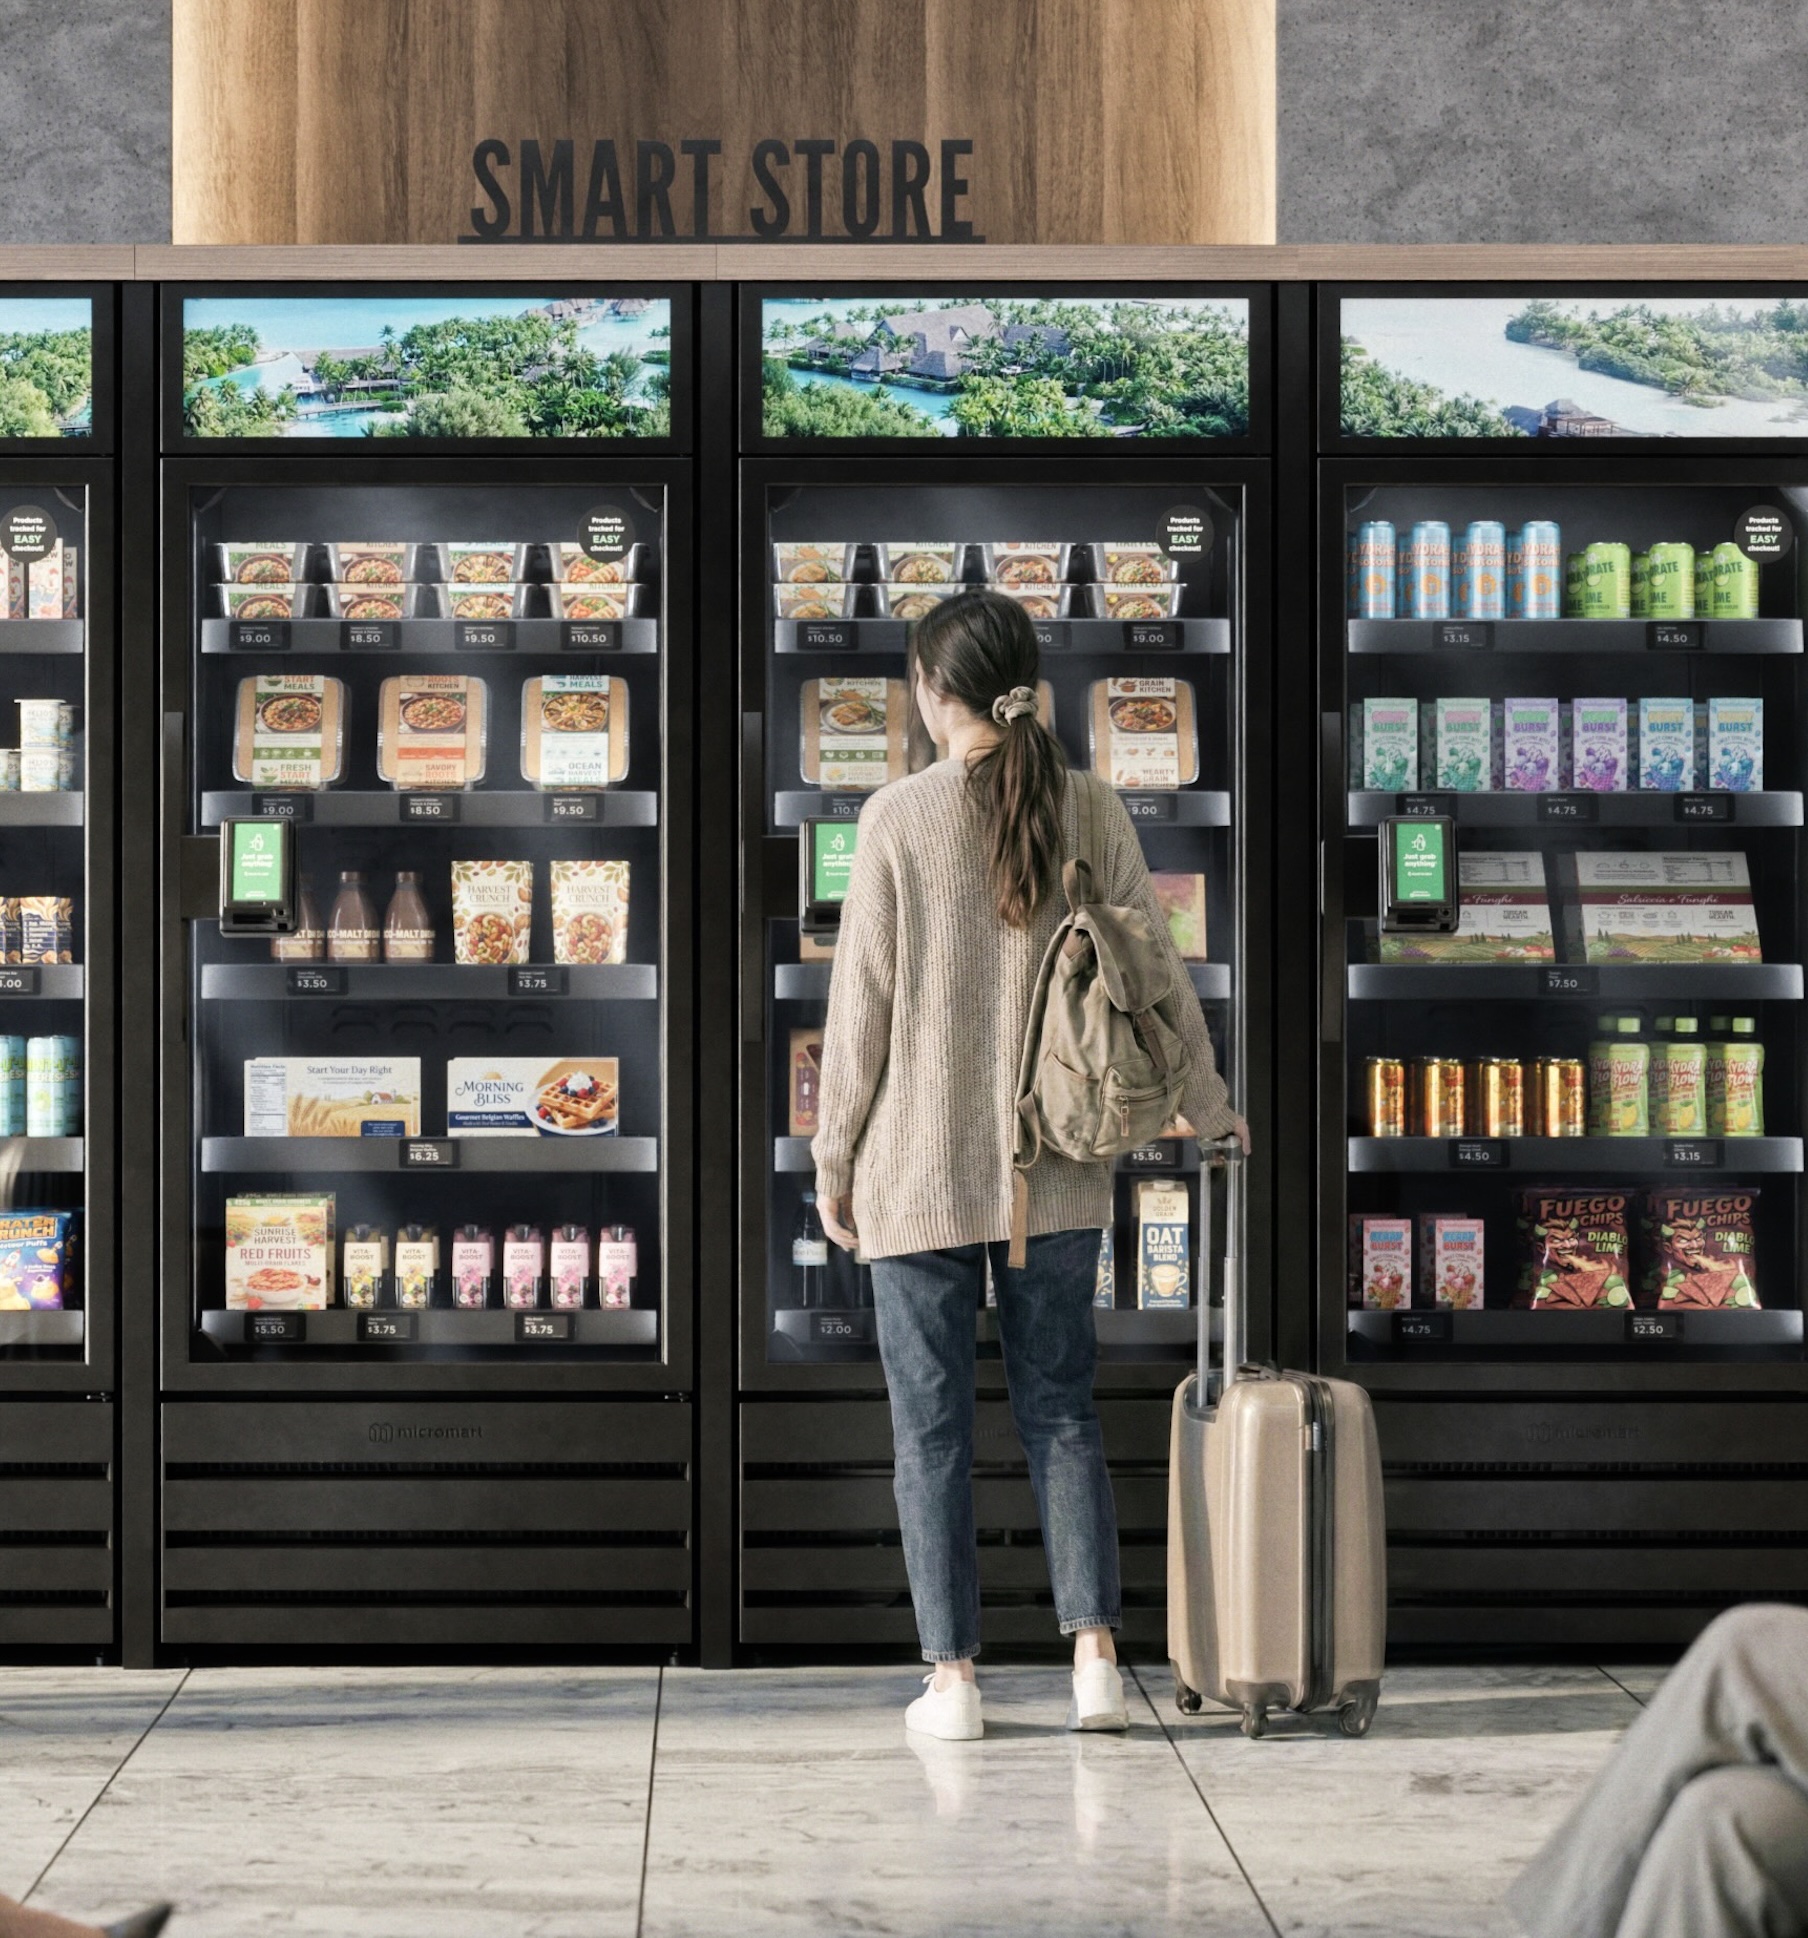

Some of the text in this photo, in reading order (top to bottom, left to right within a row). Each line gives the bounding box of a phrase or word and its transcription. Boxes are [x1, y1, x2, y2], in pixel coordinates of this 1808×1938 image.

[471, 139, 973, 238] SMART STORE
[588, 525, 625, 533] tracked for
[14, 535, 41, 543] EASY
[593, 535, 620, 543] EASY
[1171, 535, 1199, 543] EASY
[1750, 535, 1778, 543] EASY
[1025, 583, 1056, 591] KITCHEN
[240, 634, 270, 643] $9.00
[351, 634, 380, 643] $8.50
[465, 634, 495, 643] $9.50
[572, 634, 606, 643] $10.50
[808, 634, 842, 643] $10.50
[1133, 634, 1164, 643] $9.00
[1444, 635, 1469, 643] $3.15
[1657, 635, 1687, 643] $4.50
[1446, 723, 1480, 733] BURST
[1514, 723, 1548, 733] BURST
[1583, 723, 1617, 733] BURST
[1649, 723, 1683, 733] BURST
[1719, 723, 1753, 733] BURST
[569, 762, 601, 770] OCEAN
[263, 806, 294, 814] $9.00
[410, 806, 440, 814] $8.50
[554, 806, 583, 814] $9.50
[256, 853, 273, 862] grab
[470, 894, 510, 902] CRUNCH
[569, 894, 609, 902] CRUNCH
[1472, 895, 1513, 904] Funghi
[1618, 894, 1666, 904] Salsiccia
[1678, 895, 1719, 905] Funghi
[298, 979, 327, 988] $3.50
[519, 980, 546, 988] $3.75
[1549, 980, 1577, 988] $7.50
[307, 1066, 392, 1076] Start Your Day Right
[1612, 1059, 1643, 1074] HYDRA
[1668, 1059, 1701, 1074] HYDRA
[1726, 1059, 1758, 1074] HYDRA
[1612, 1073, 1642, 1091] FLOW
[1669, 1073, 1698, 1091] FLOW
[1728, 1072, 1754, 1090] FLOW
[455, 1081, 523, 1096] MORNING
[474, 1094, 511, 1106] BLISS
[482, 1114, 502, 1122] Belgian
[1133, 1152, 1162, 1161] $5.50
[1459, 1152, 1489, 1161] $4.50
[1675, 1152, 1700, 1161] $3.15
[1540, 1197, 1626, 1219] FUEGO
[1666, 1197, 1752, 1219] FUEGO
[1580, 1213, 1624, 1226] CHIPS
[1707, 1213, 1751, 1226] CHIPS
[0, 1226, 54, 1239] RUNCH
[1147, 1228, 1184, 1244] OAT
[1588, 1232, 1627, 1245] DIABLO
[1715, 1232, 1755, 1245] DIABLO
[1147, 1246, 1184, 1254] BARISTA
[1371, 1242, 1403, 1250] BURST
[1443, 1242, 1476, 1250] BURST
[1595, 1242, 1623, 1254] LIME
[1722, 1242, 1751, 1254] LIME
[240, 1248, 311, 1259] RED FRUITS
[255, 1326, 284, 1334] $5.50
[368, 1326, 396, 1334] $3.75
[525, 1326, 553, 1334] $3.75
[821, 1326, 851, 1334] $2.00
[1402, 1326, 1431, 1334] $4.75
[1634, 1326, 1663, 1334] $2.50
[398, 1425, 482, 1438] micromart
